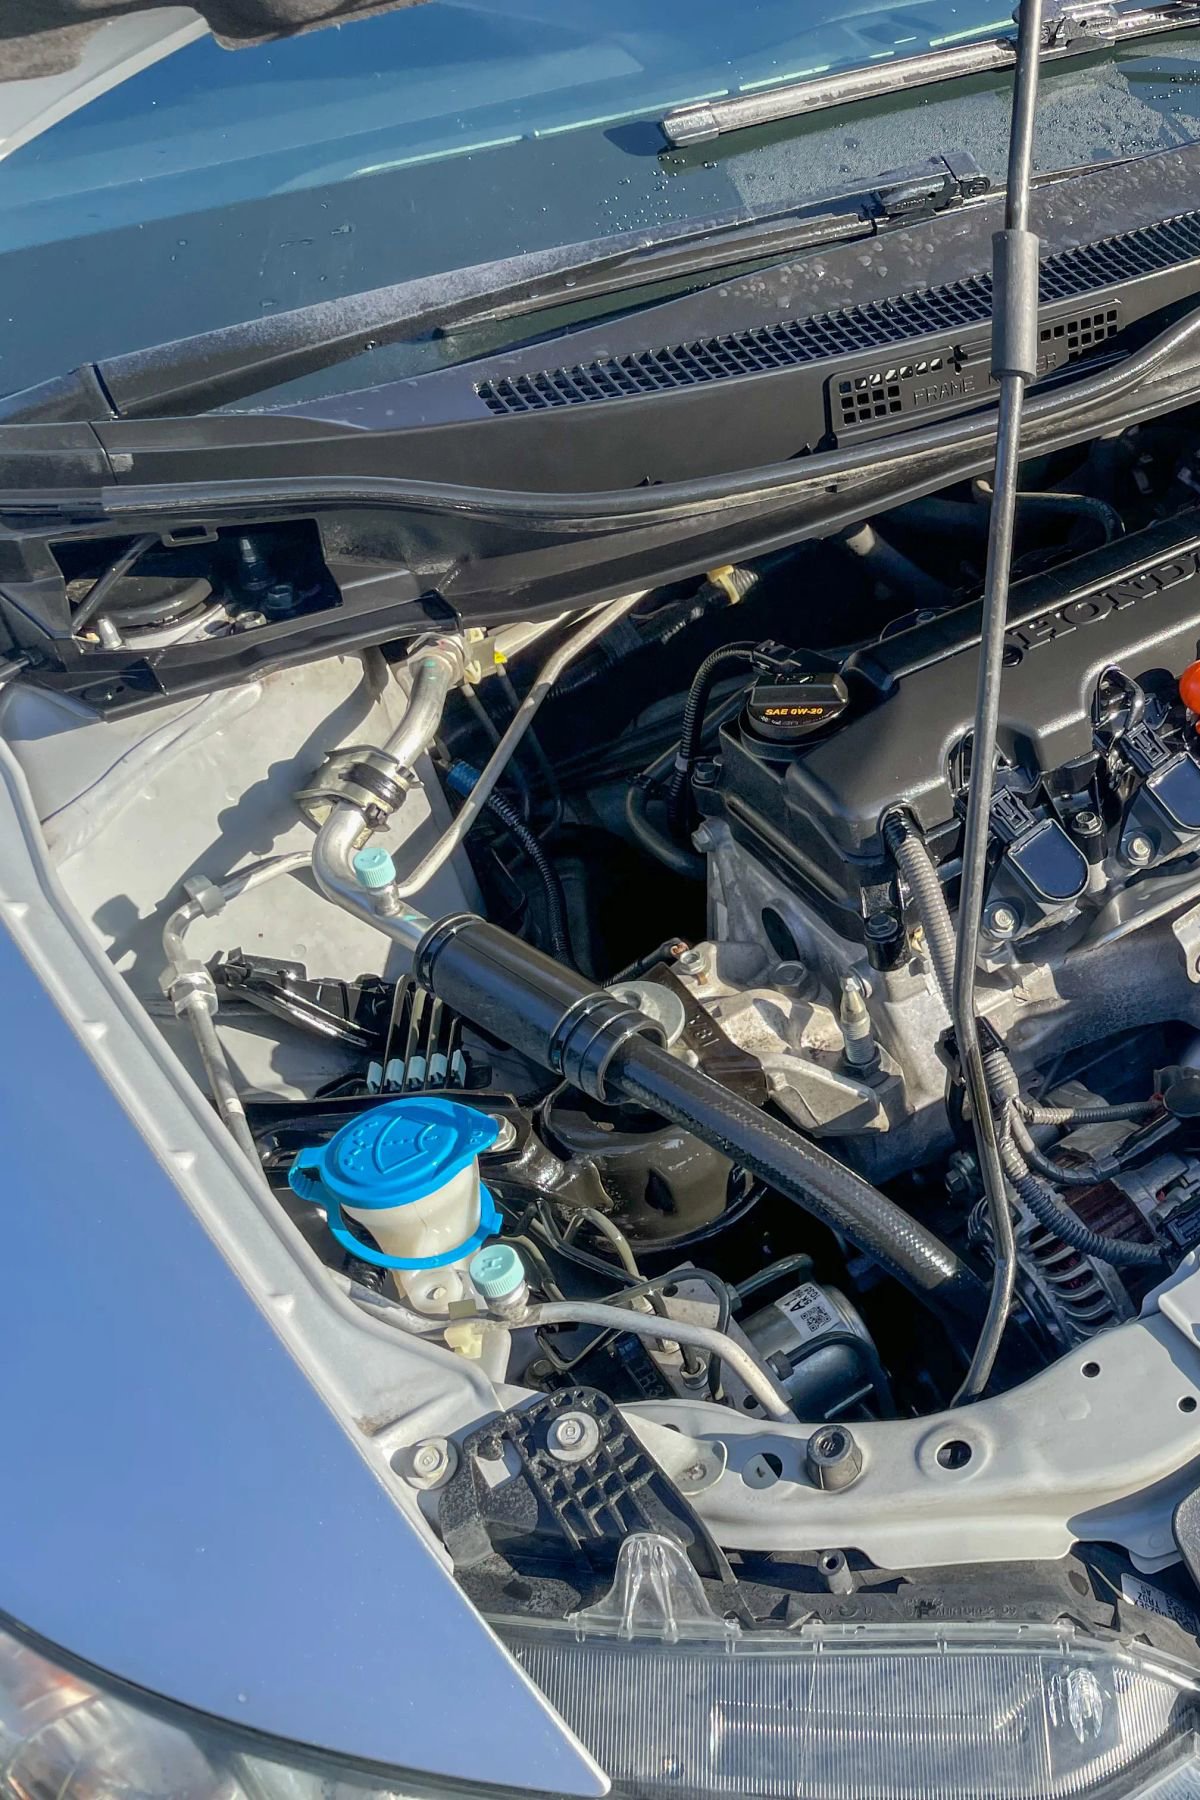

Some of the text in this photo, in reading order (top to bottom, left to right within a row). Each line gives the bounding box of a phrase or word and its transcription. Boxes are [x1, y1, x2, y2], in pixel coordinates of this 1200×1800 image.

[913, 375, 975, 405] FRAME
[765, 707, 823, 716] SAE 0W-20
